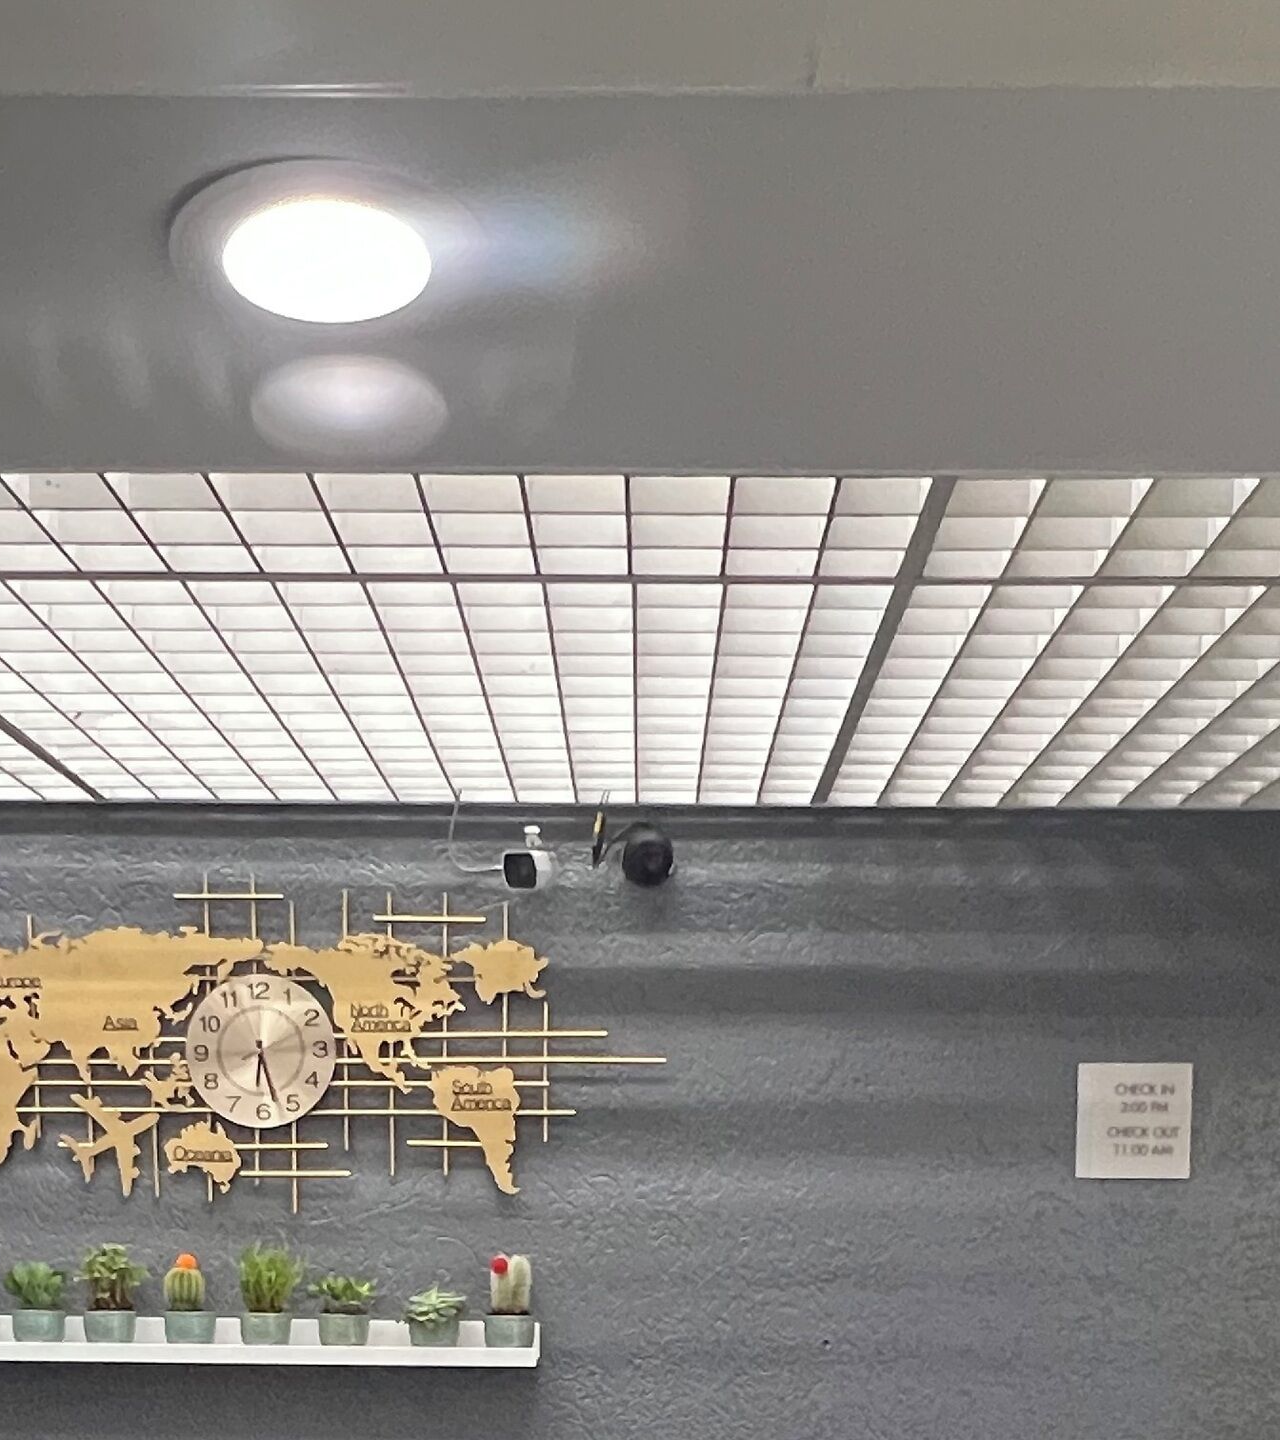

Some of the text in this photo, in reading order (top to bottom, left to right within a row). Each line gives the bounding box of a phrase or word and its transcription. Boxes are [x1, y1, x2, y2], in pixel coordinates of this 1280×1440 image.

[220, 990, 238, 1008] 11
[246, 982, 271, 1000] 12
[283, 988, 292, 1005] 1
[303, 1008, 320, 1027] 2
[350, 1002, 390, 1019] North
[103, 1015, 139, 1031] Asia
[199, 1015, 221, 1033] 10
[350, 1018, 412, 1033] America
[194, 1044, 209, 1062] 9
[312, 1040, 328, 1058] 3
[204, 1073, 219, 1090] 8
[305, 1071, 320, 1088] 4
[452, 1079, 493, 1094] South
[1114, 1083, 1176, 1096] CHECK IN
[225, 1095, 242, 1113] 7
[285, 1094, 301, 1112] 5
[451, 1095, 512, 1111] America
[1150, 1101, 1169, 1113] PM
[256, 1103, 272, 1121] 6
[1106, 1126, 1181, 1139] CHECK OUT
[173, 1145, 234, 1162] Oceania
[1151, 1145, 1175, 1156] AM
